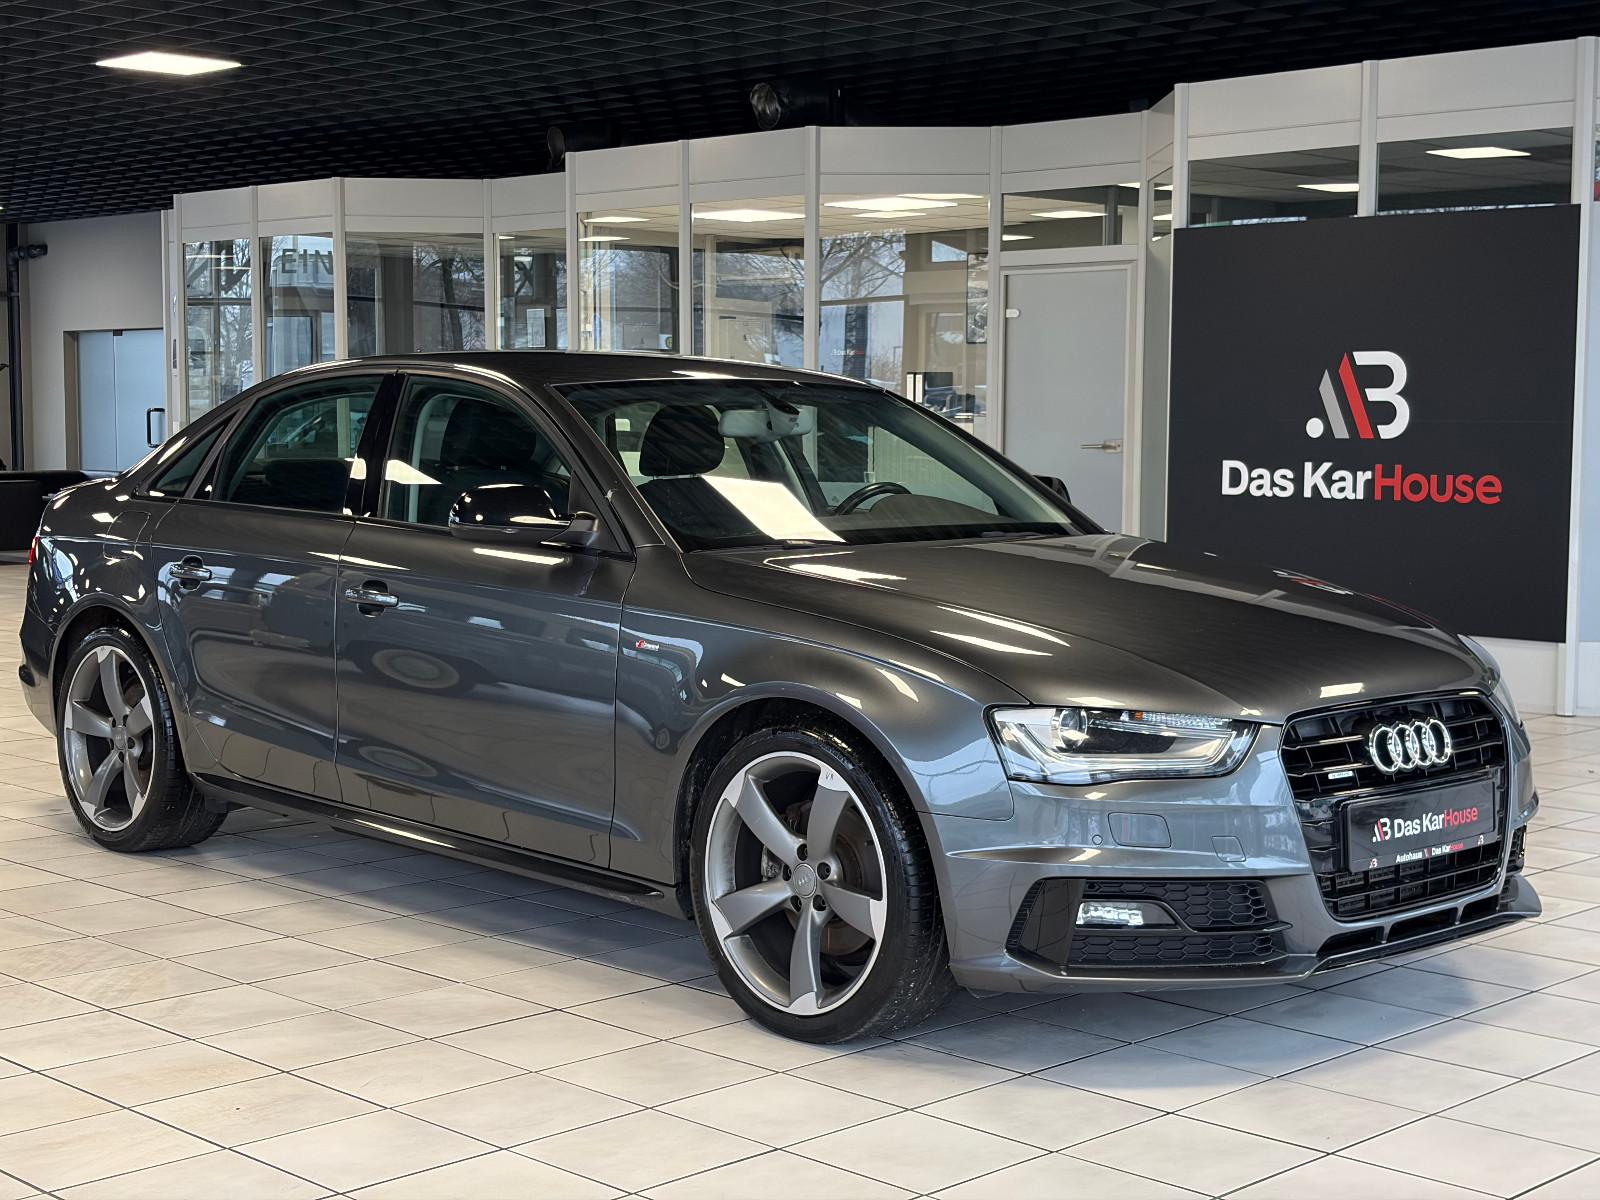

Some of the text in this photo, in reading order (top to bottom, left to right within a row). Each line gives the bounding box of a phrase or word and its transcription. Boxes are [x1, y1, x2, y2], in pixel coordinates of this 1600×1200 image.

[1221, 459, 1503, 505] Das KarHouse
[1394, 818, 1421, 839] Das
[1422, 806, 1478, 833] KarHouse
[1395, 850, 1423, 864] Autohaus
[1431, 846, 1441, 856] Das
